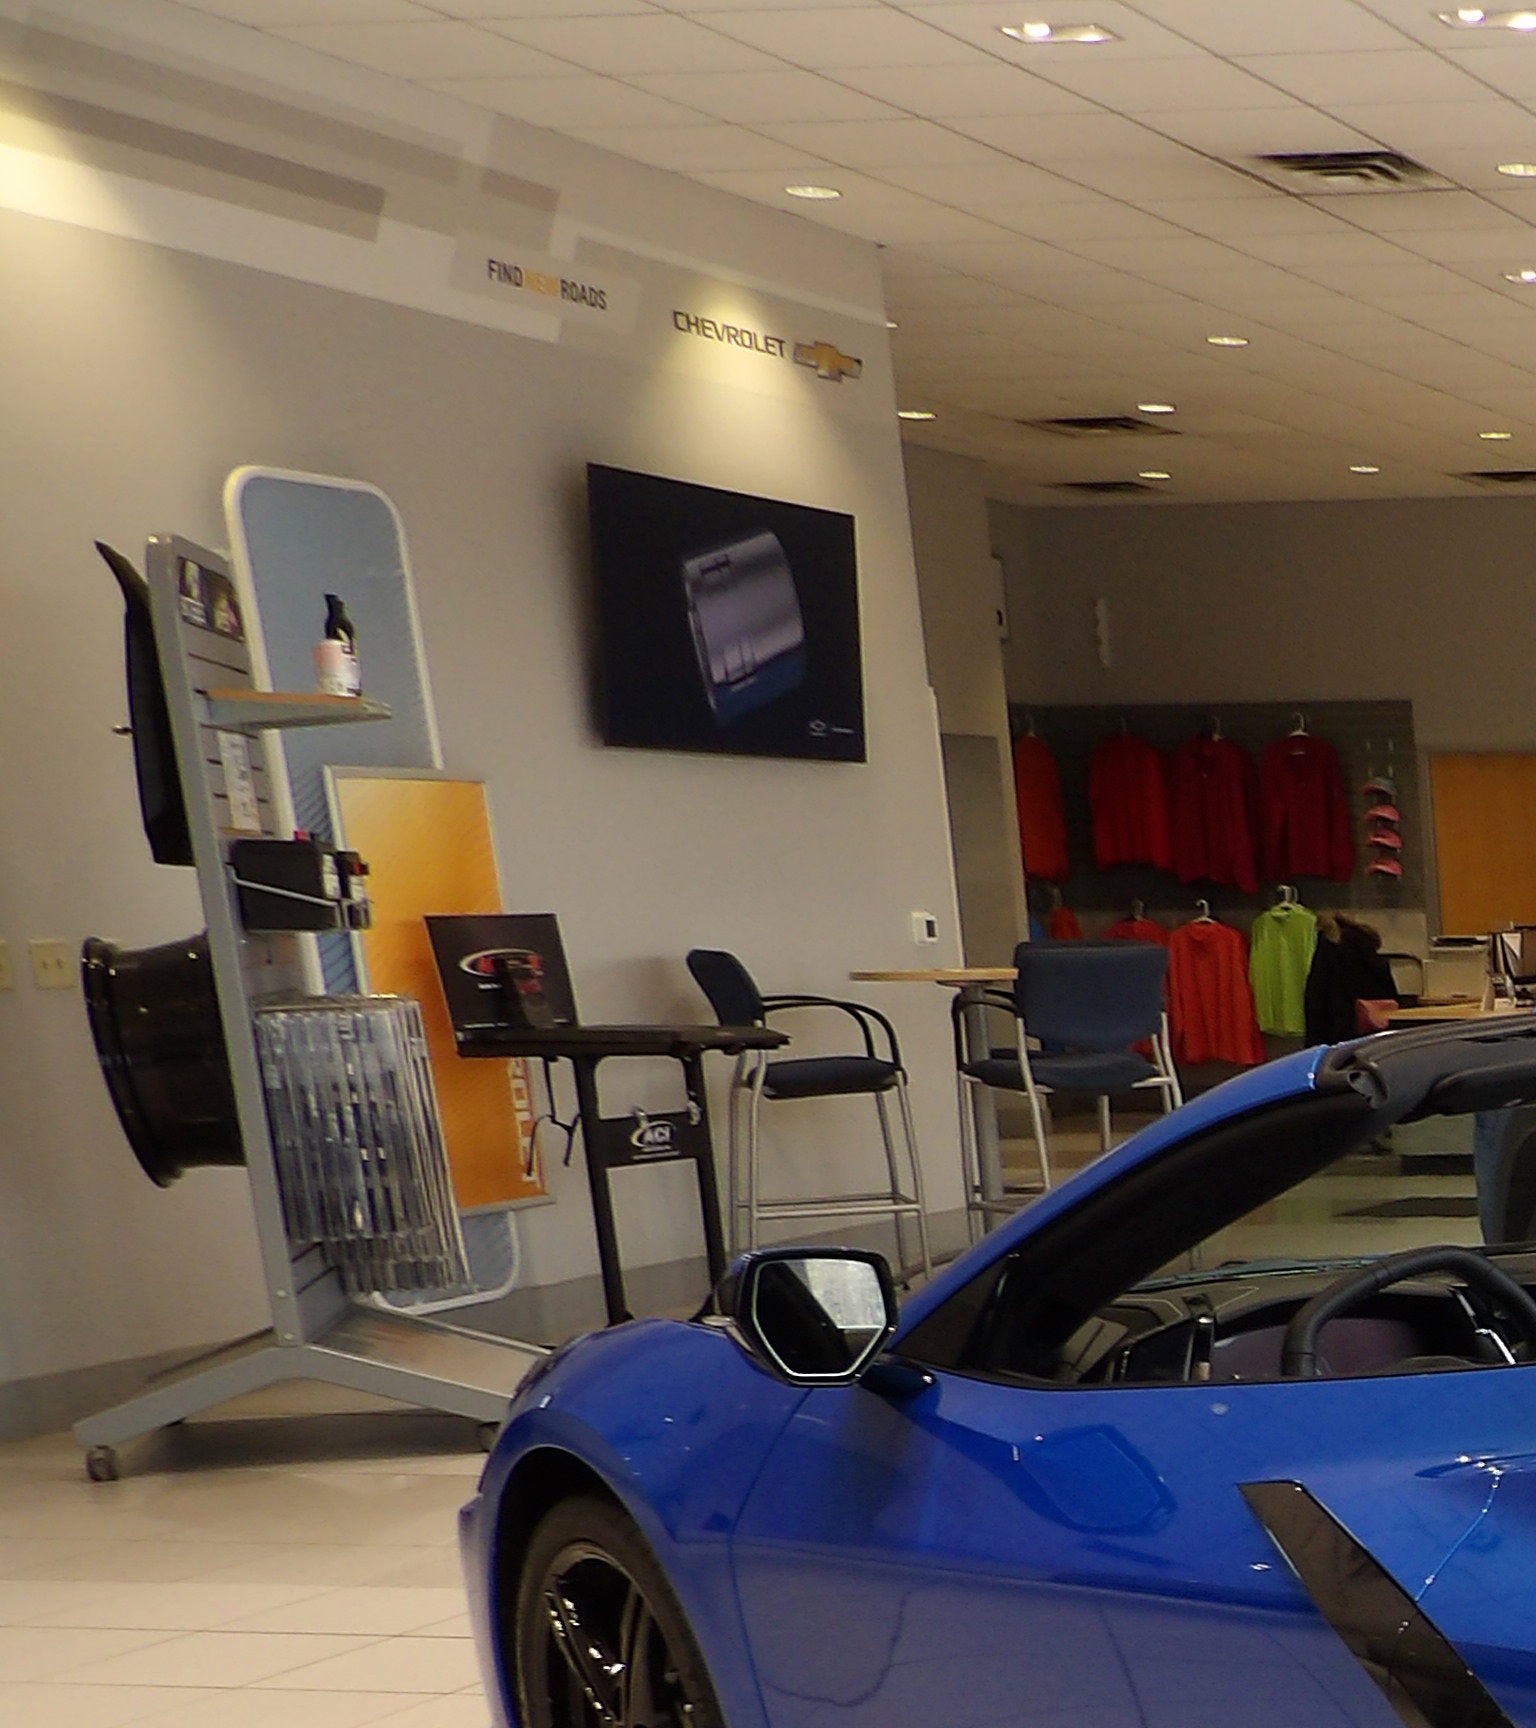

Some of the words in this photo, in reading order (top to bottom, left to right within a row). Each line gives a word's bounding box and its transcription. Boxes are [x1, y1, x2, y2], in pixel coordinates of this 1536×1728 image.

[487, 258, 523, 289] FIND
[560, 278, 607, 311] ROADS
[673, 310, 786, 359] CHEVROLET
